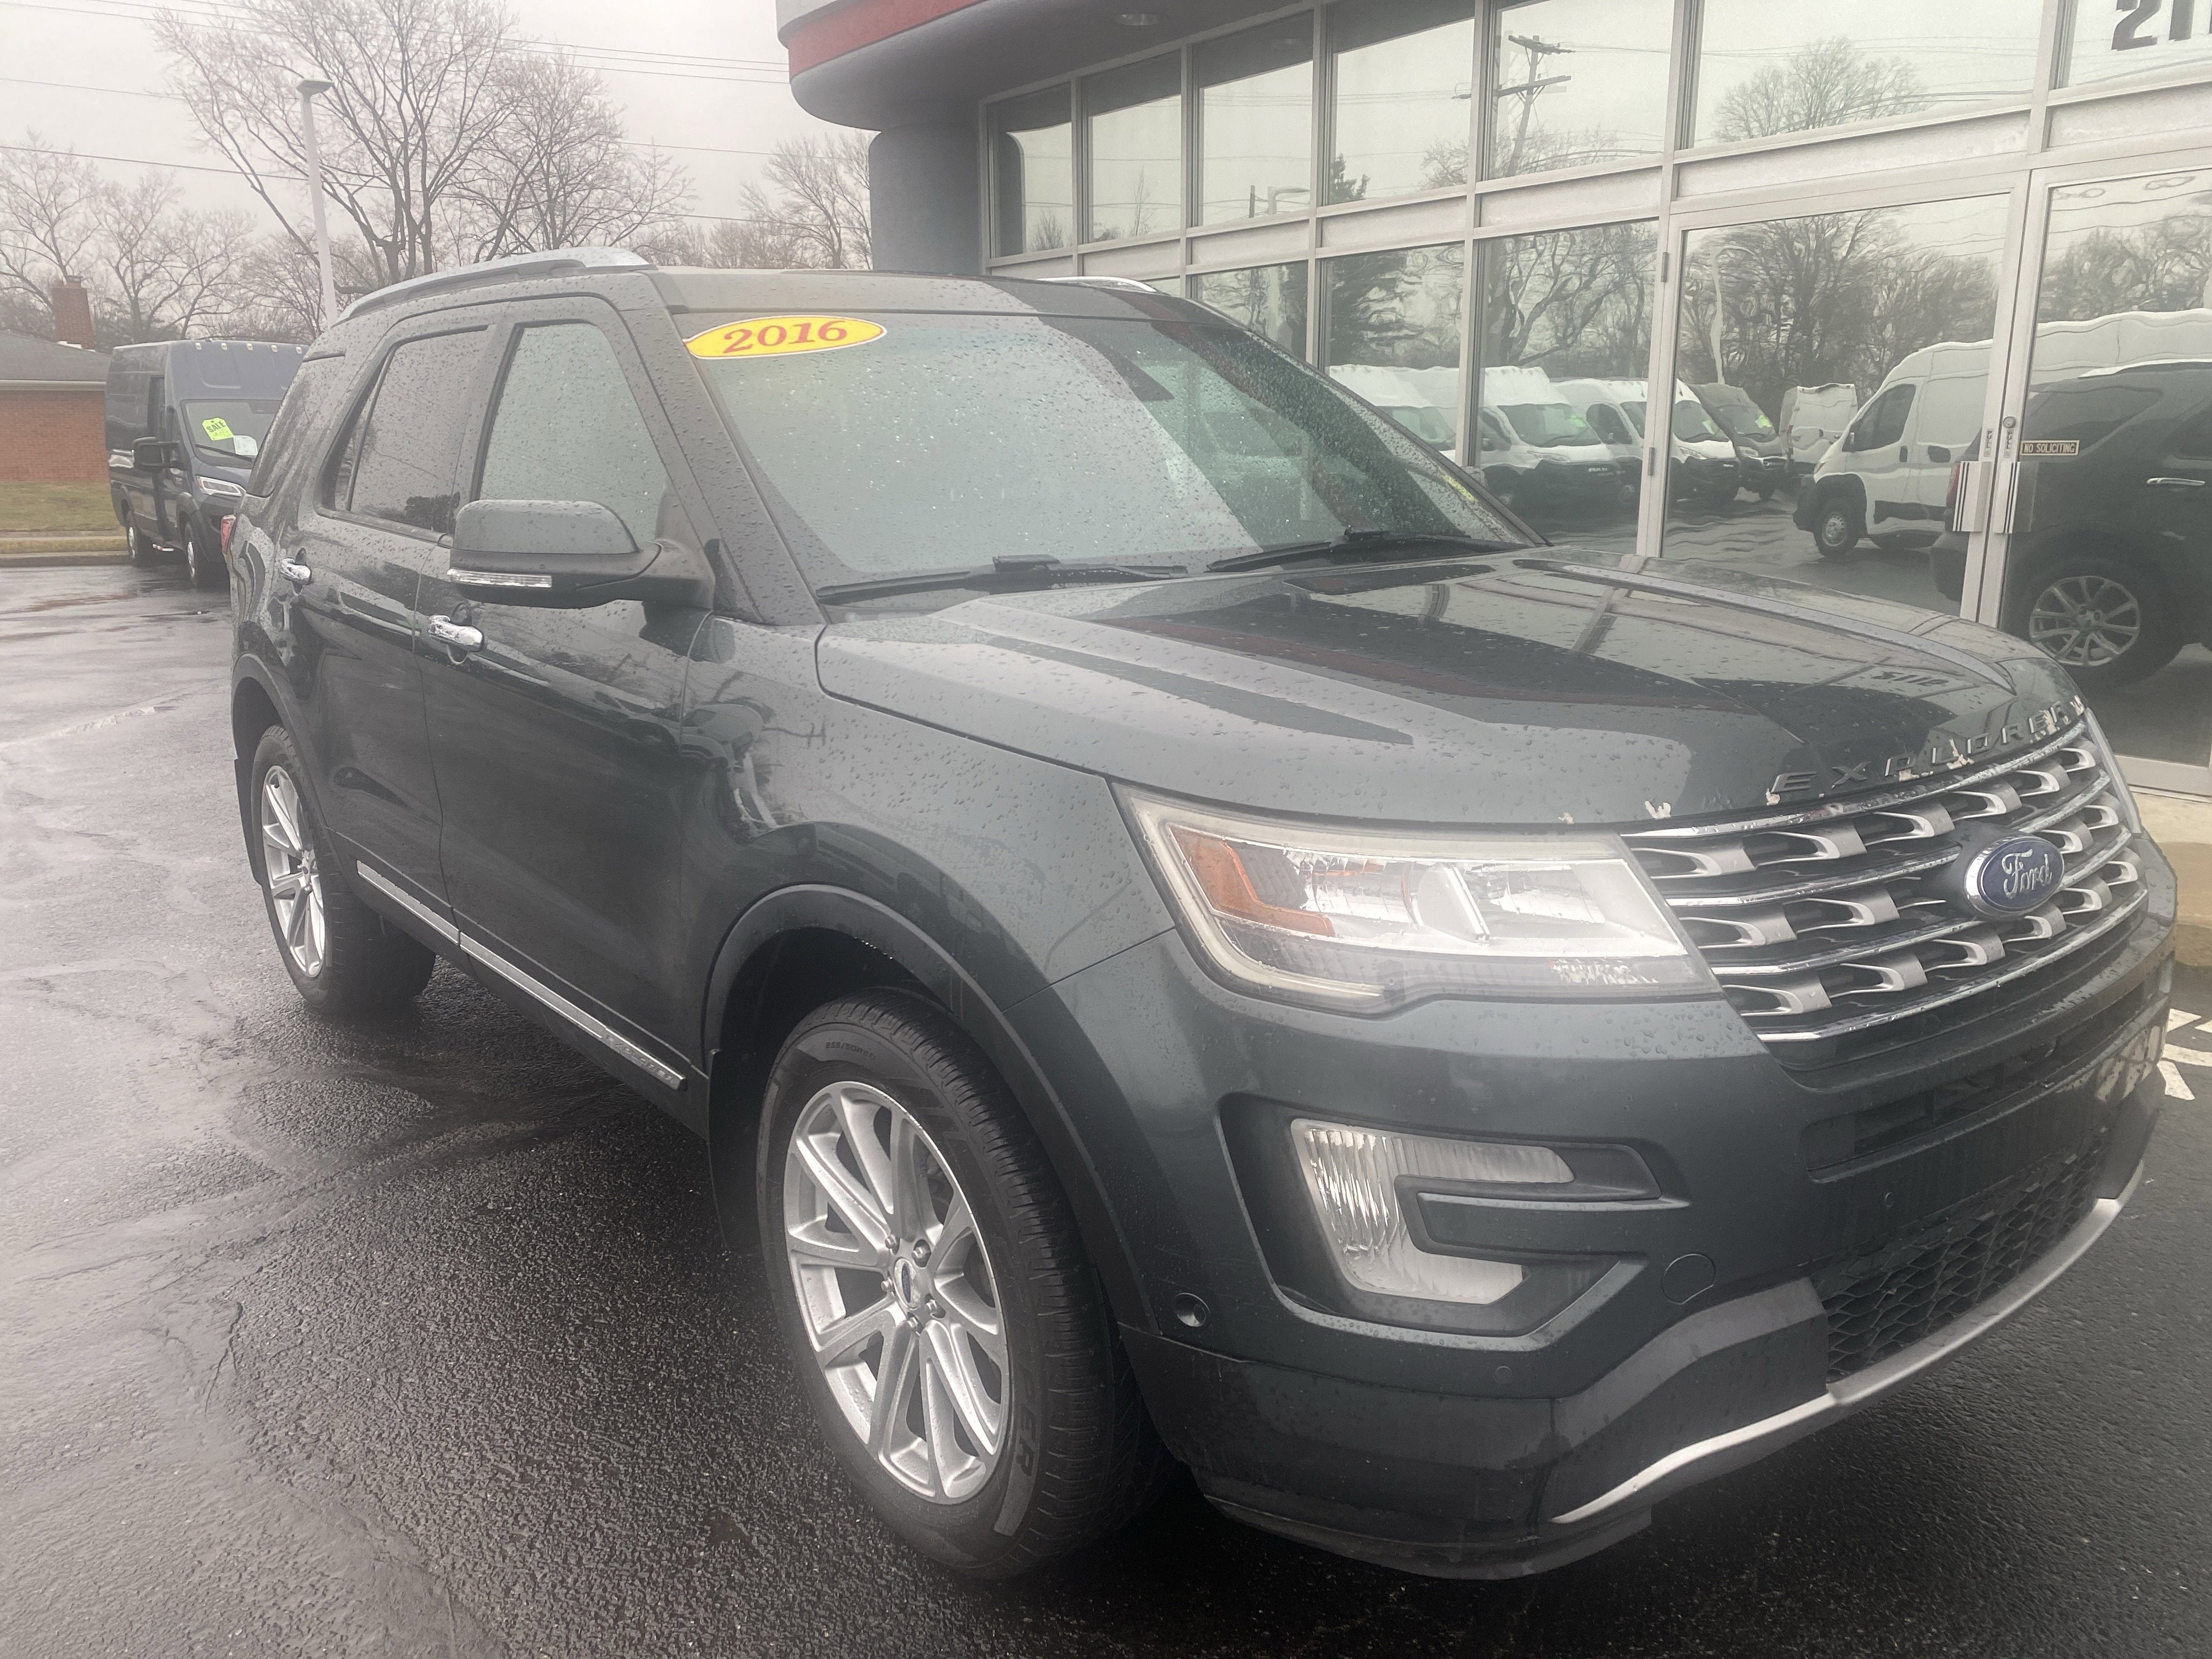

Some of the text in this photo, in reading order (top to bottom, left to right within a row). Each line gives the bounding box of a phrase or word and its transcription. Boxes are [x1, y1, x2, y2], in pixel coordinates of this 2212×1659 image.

[723, 320, 847, 354] 2016
[206, 421, 226, 432] SALE
[2024, 443, 2076, 453] NO SOLICITING
[1770, 701, 2067, 793] EXPLORER
[2001, 848, 2052, 899] Ford
